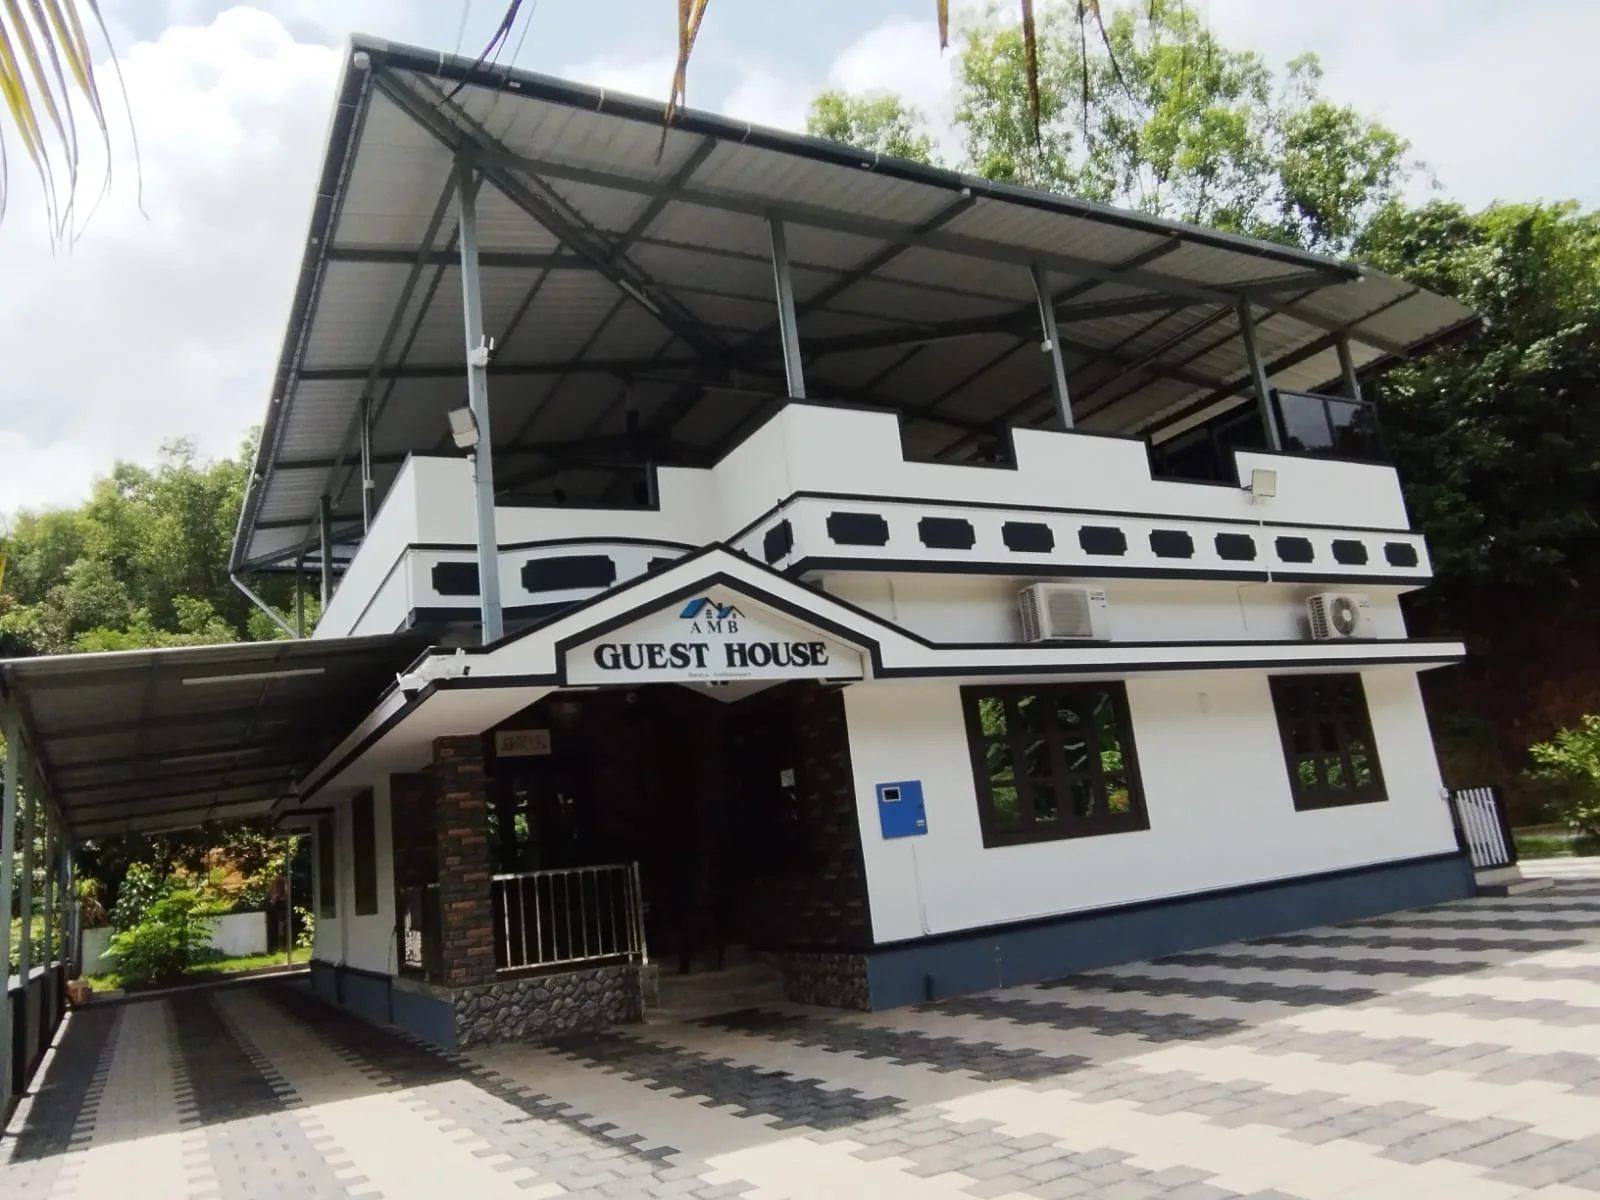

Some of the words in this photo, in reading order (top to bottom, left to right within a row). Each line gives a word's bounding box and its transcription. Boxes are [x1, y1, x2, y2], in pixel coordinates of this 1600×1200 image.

[690, 620, 738, 634] AMB
[593, 643, 709, 670] GUEST
[723, 641, 829, 668] HOUSE
